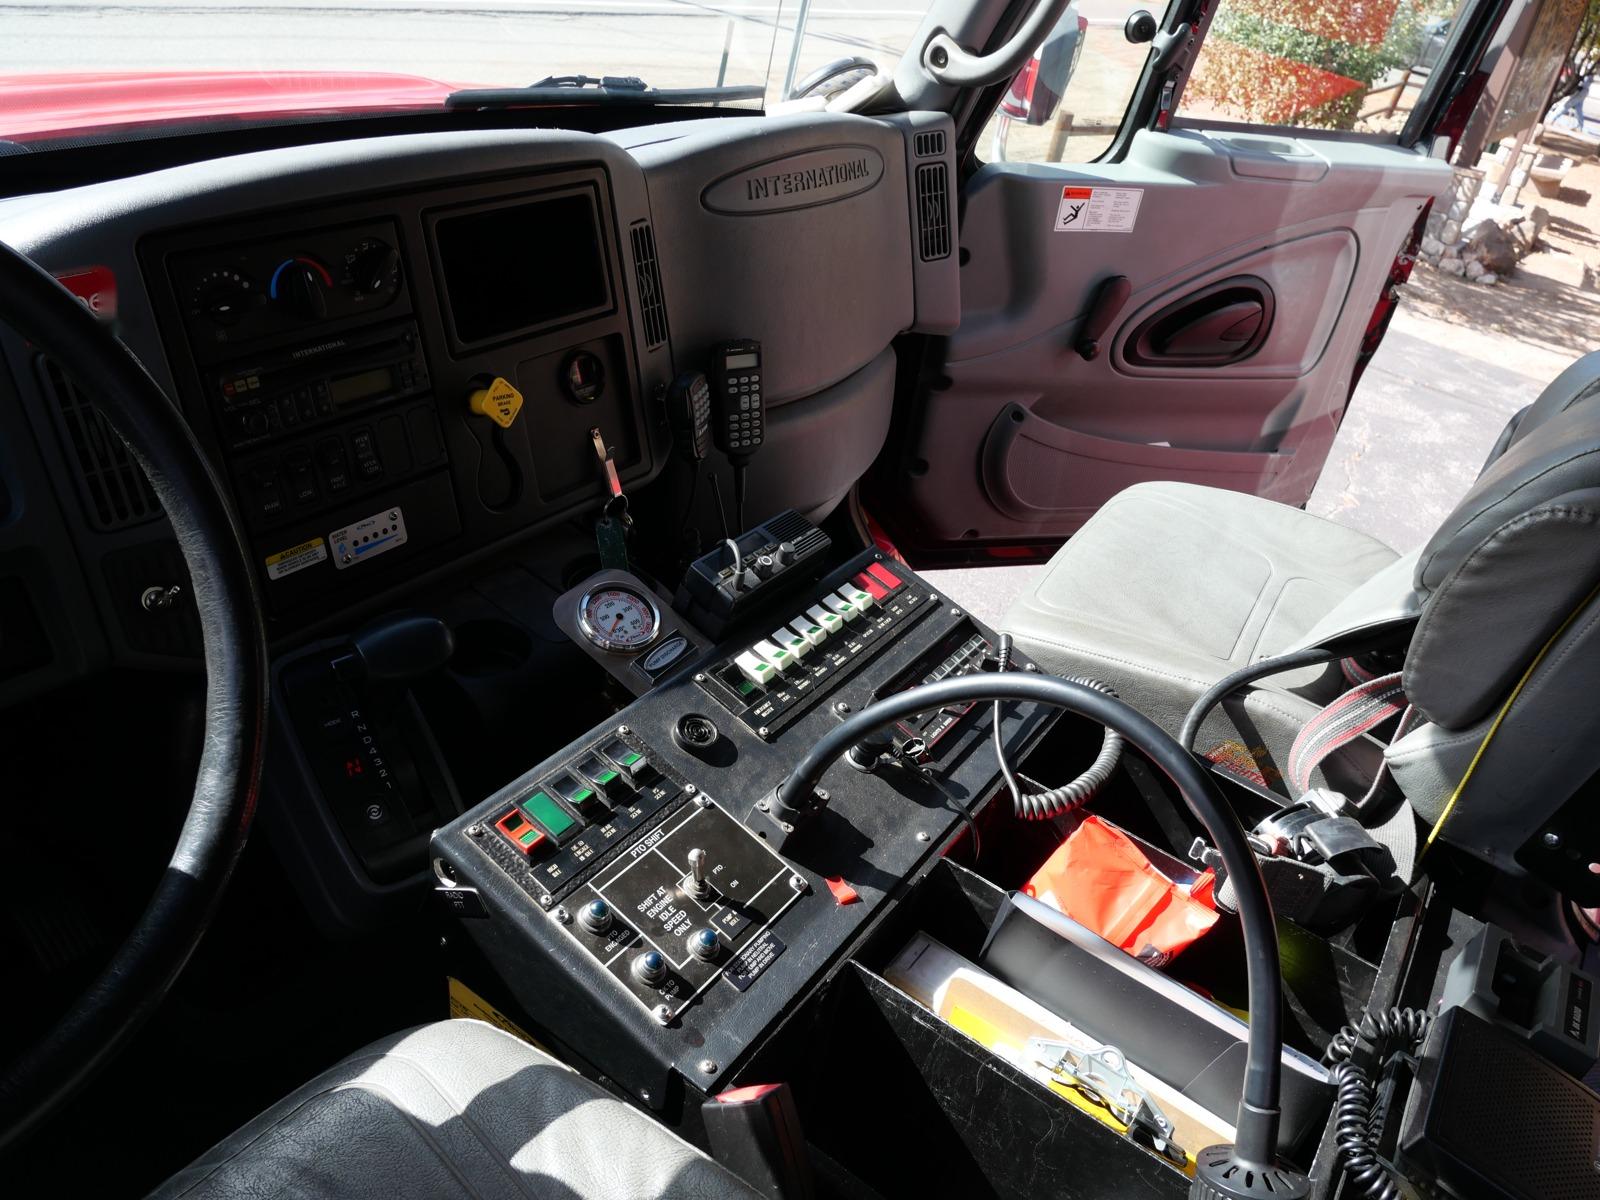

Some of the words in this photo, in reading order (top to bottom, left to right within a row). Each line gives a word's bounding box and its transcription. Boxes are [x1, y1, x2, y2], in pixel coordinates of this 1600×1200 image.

[745, 157, 870, 201] INTERNATIONAL
[292, 341, 346, 358] INTERNATIONAL
[492, 391, 514, 401] PARKING
[286, 543, 313, 558] CAUTION
[599, 613, 610, 621] 100
[622, 605, 633, 613] 300
[649, 658, 661, 668] PUMP
[660, 642, 682, 659] DISCHARGE
[350, 709, 360, 718] R
[356, 722, 368, 733] N
[362, 735, 373, 744] D
[374, 757, 383, 767] 3
[379, 769, 388, 778] 2
[386, 781, 393, 790] 1
[630, 840, 650, 858] PTO
[645, 829, 665, 850] SHIFT
[712, 864, 724, 875] PTO
[730, 879, 739, 888] ON
[445, 891, 464, 900] RADIO
[637, 892, 660, 913] SHIFT
[655, 886, 667, 898] AT
[453, 901, 465, 909] PTT
[646, 894, 673, 919] ENGINE
[658, 906, 677, 923] IDLE
[663, 910, 687, 933] SPEED
[722, 913, 734, 926] PUMP
[606, 929, 619, 941] PTO
[673, 919, 692, 938] ONLY
[605, 929, 631, 953] ENGAGED
[754, 930, 771, 948] PUMPING
[751, 941, 769, 959] NEUTRAL
[756, 952, 766, 962] AND
[764, 942, 776, 955] MOVE
[748, 966, 760, 979] PUMP
[763, 951, 775, 964] DRIVE
[664, 984, 681, 1001] PUMP
[1572, 1005, 1583, 1023] RADIO
